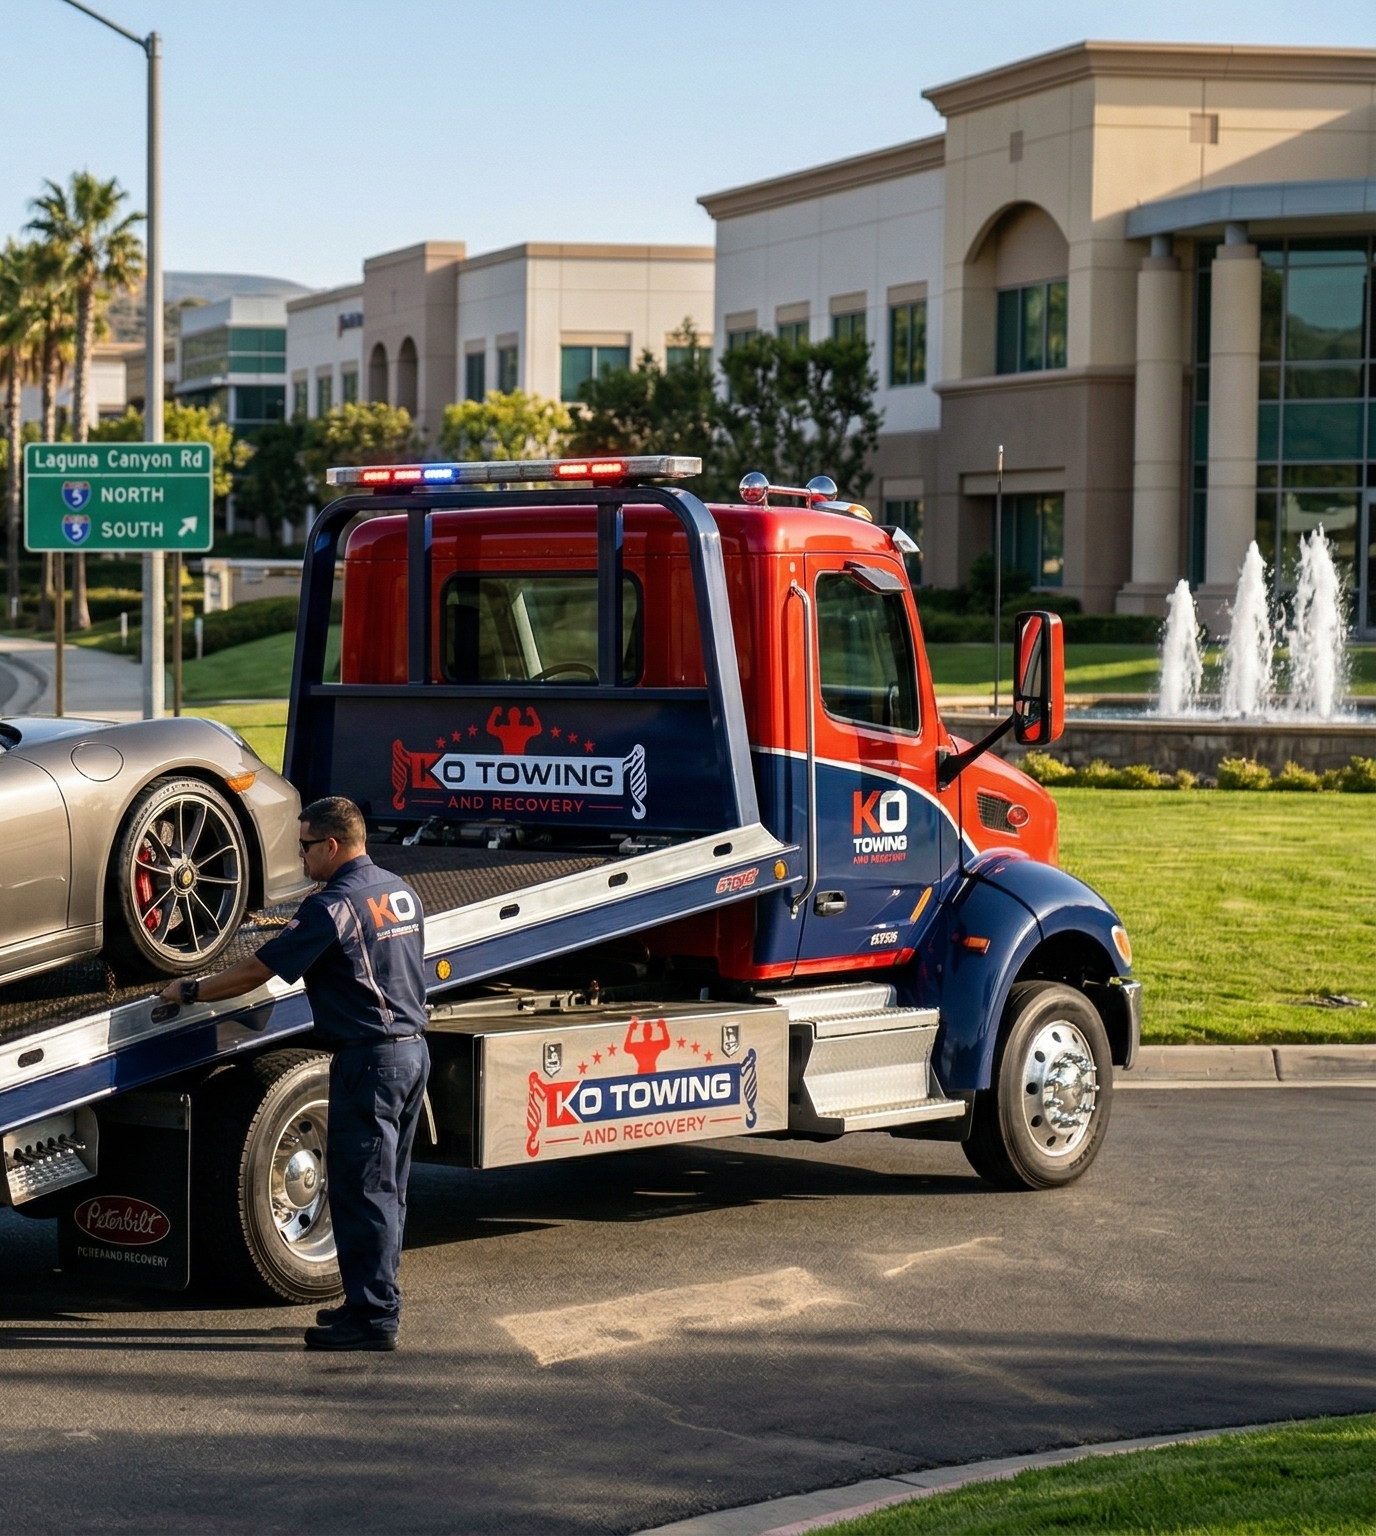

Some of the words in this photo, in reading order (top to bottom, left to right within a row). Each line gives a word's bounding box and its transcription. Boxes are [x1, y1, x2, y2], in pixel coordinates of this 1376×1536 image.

[35, 450, 99, 472] Laguna
[107, 450, 172, 472] Canyon
[180, 450, 203, 468] Rd
[72, 489, 83, 506] 5
[101, 487, 164, 503] NORTH
[72, 523, 83, 540] 5
[101, 521, 164, 538] SOUTH
[475, 761, 614, 788] TOWING
[448, 796, 484, 810] AND
[492, 798, 585, 813] RECOVERY
[852, 789, 908, 835] KO
[852, 835, 908, 854] TOWING
[366, 890, 416, 929] KO
[551, 1081, 603, 1125] KO
[609, 1072, 732, 1112] TOWING
[582, 1127, 618, 1146] AND
[623, 1115, 707, 1141] RECOVERY
[86, 1201, 162, 1234] Peterbilt
[124, 1251, 169, 1268] RECOVERY
